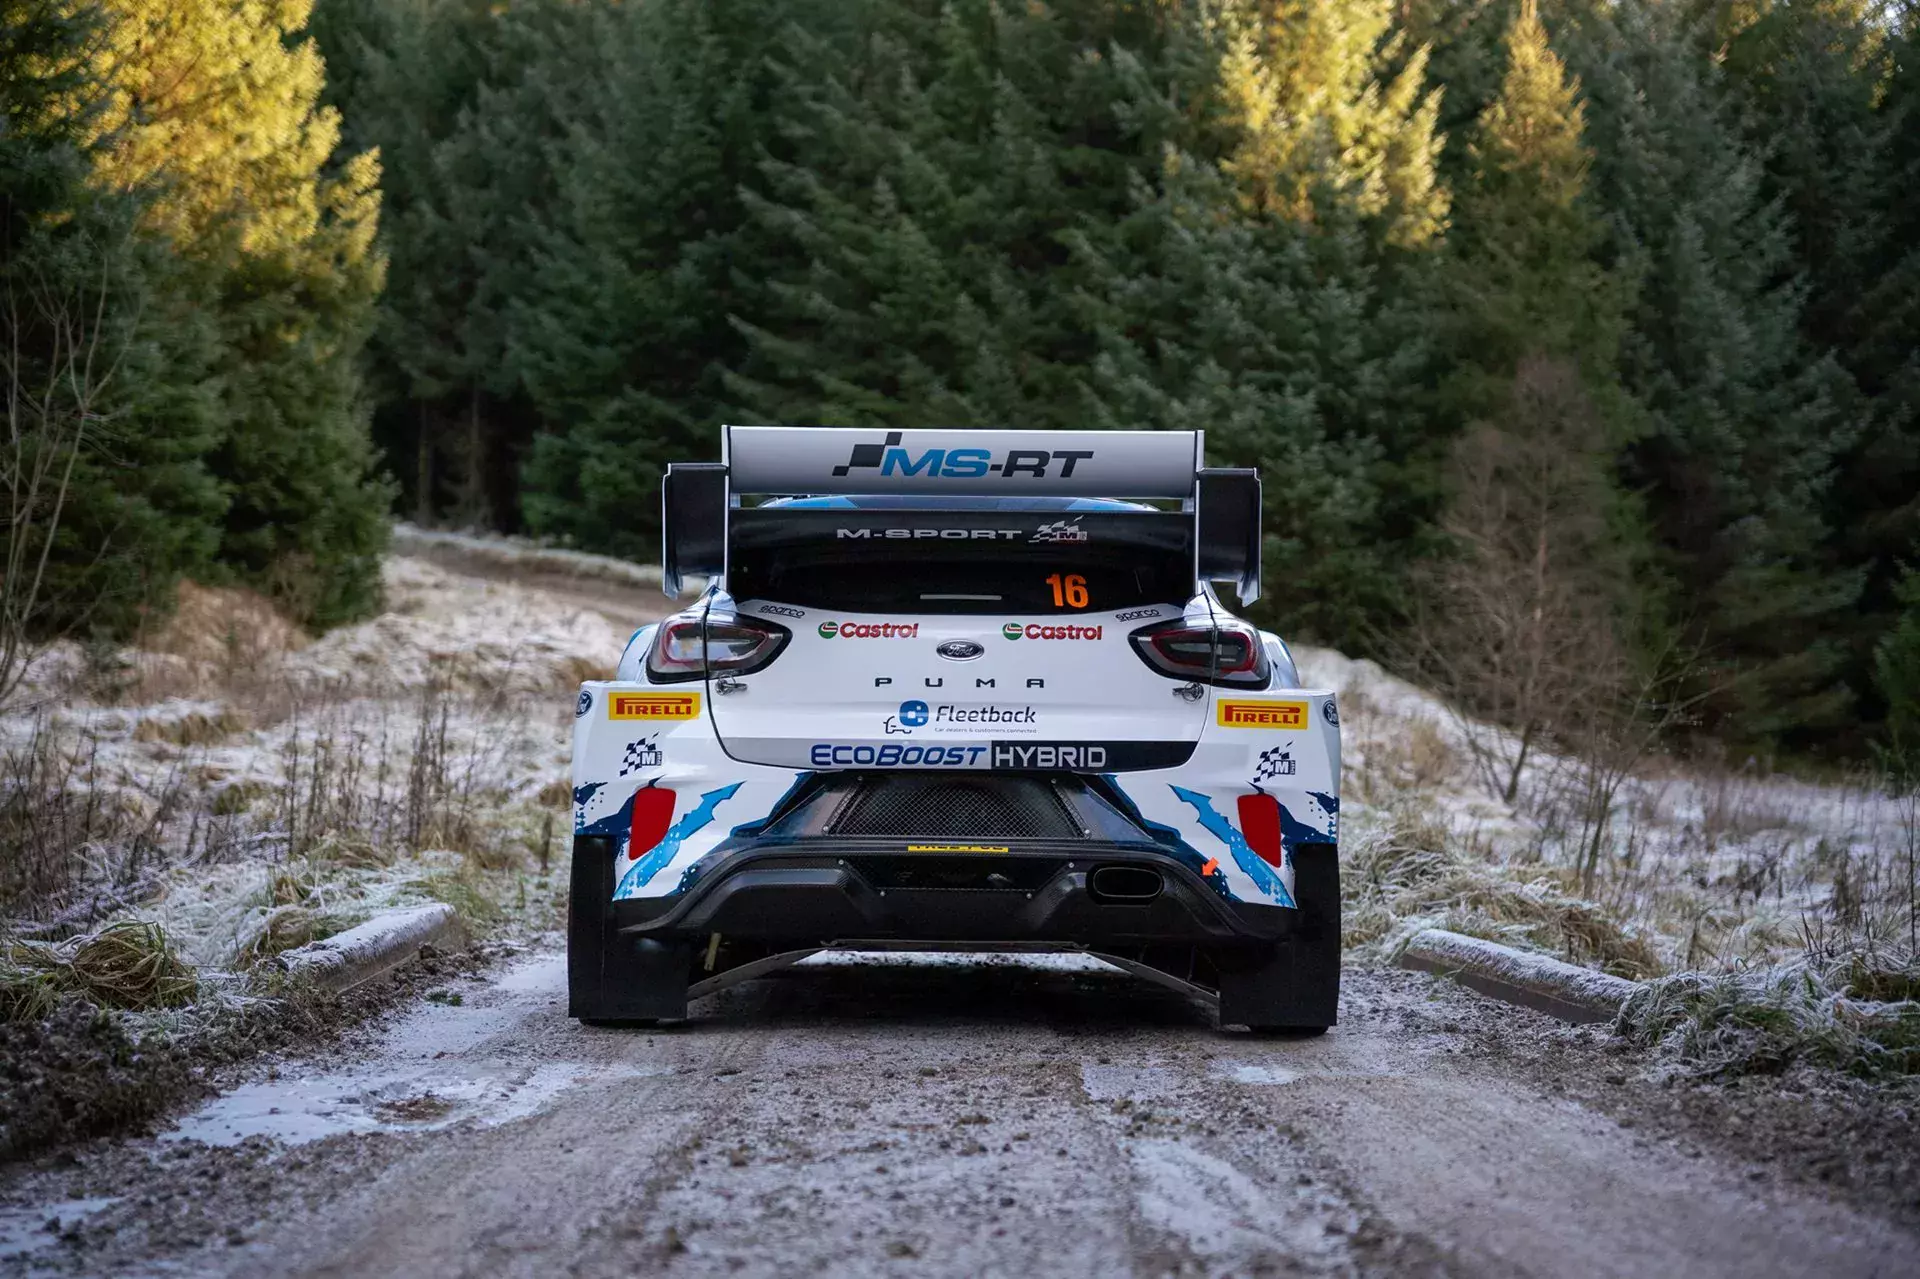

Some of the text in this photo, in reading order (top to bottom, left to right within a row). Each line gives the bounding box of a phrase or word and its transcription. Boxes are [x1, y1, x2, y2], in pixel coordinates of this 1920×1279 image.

[880, 448, 1094, 478] MS-RT
[836, 528, 1022, 540] M-SPORT
[1046, 573, 1089, 608] 16
[757, 604, 806, 619] sparco
[1115, 608, 1162, 622] sparco
[839, 622, 919, 639] Castrol
[1025, 623, 1102, 641] Castrol
[946, 643, 974, 657] Ford
[874, 677, 1045, 688] PUMA
[616, 698, 693, 715] PIRELLI
[935, 705, 1036, 723] Fleetback
[1224, 705, 1301, 724] PIRELLI
[641, 752, 656, 765] M
[995, 746, 1106, 768] HYBRID
[1274, 761, 1290, 775] M
